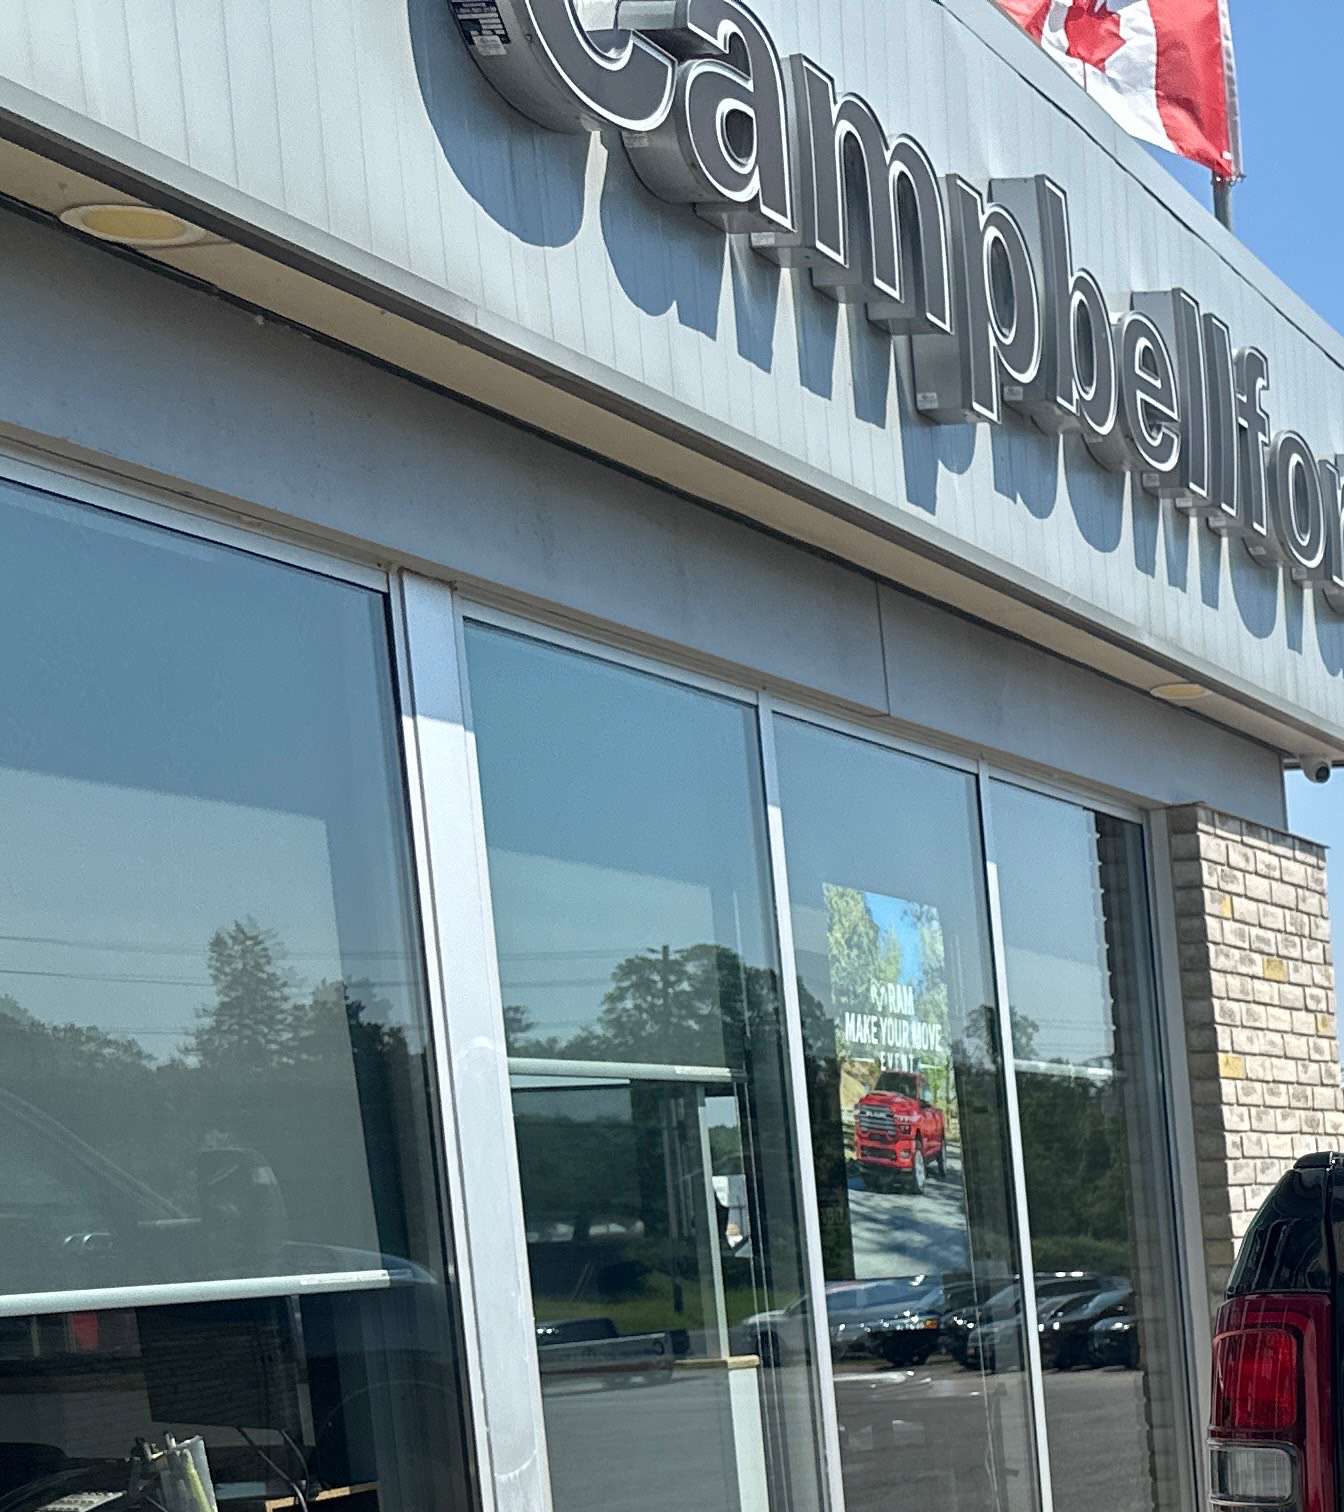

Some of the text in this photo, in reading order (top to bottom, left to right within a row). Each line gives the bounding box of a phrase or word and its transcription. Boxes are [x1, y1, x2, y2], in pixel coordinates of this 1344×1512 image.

[887, 982, 915, 1016] RAM
[845, 1011, 942, 1052] MAKE YOUR MOVE
[880, 1051, 914, 1074] EVENT
